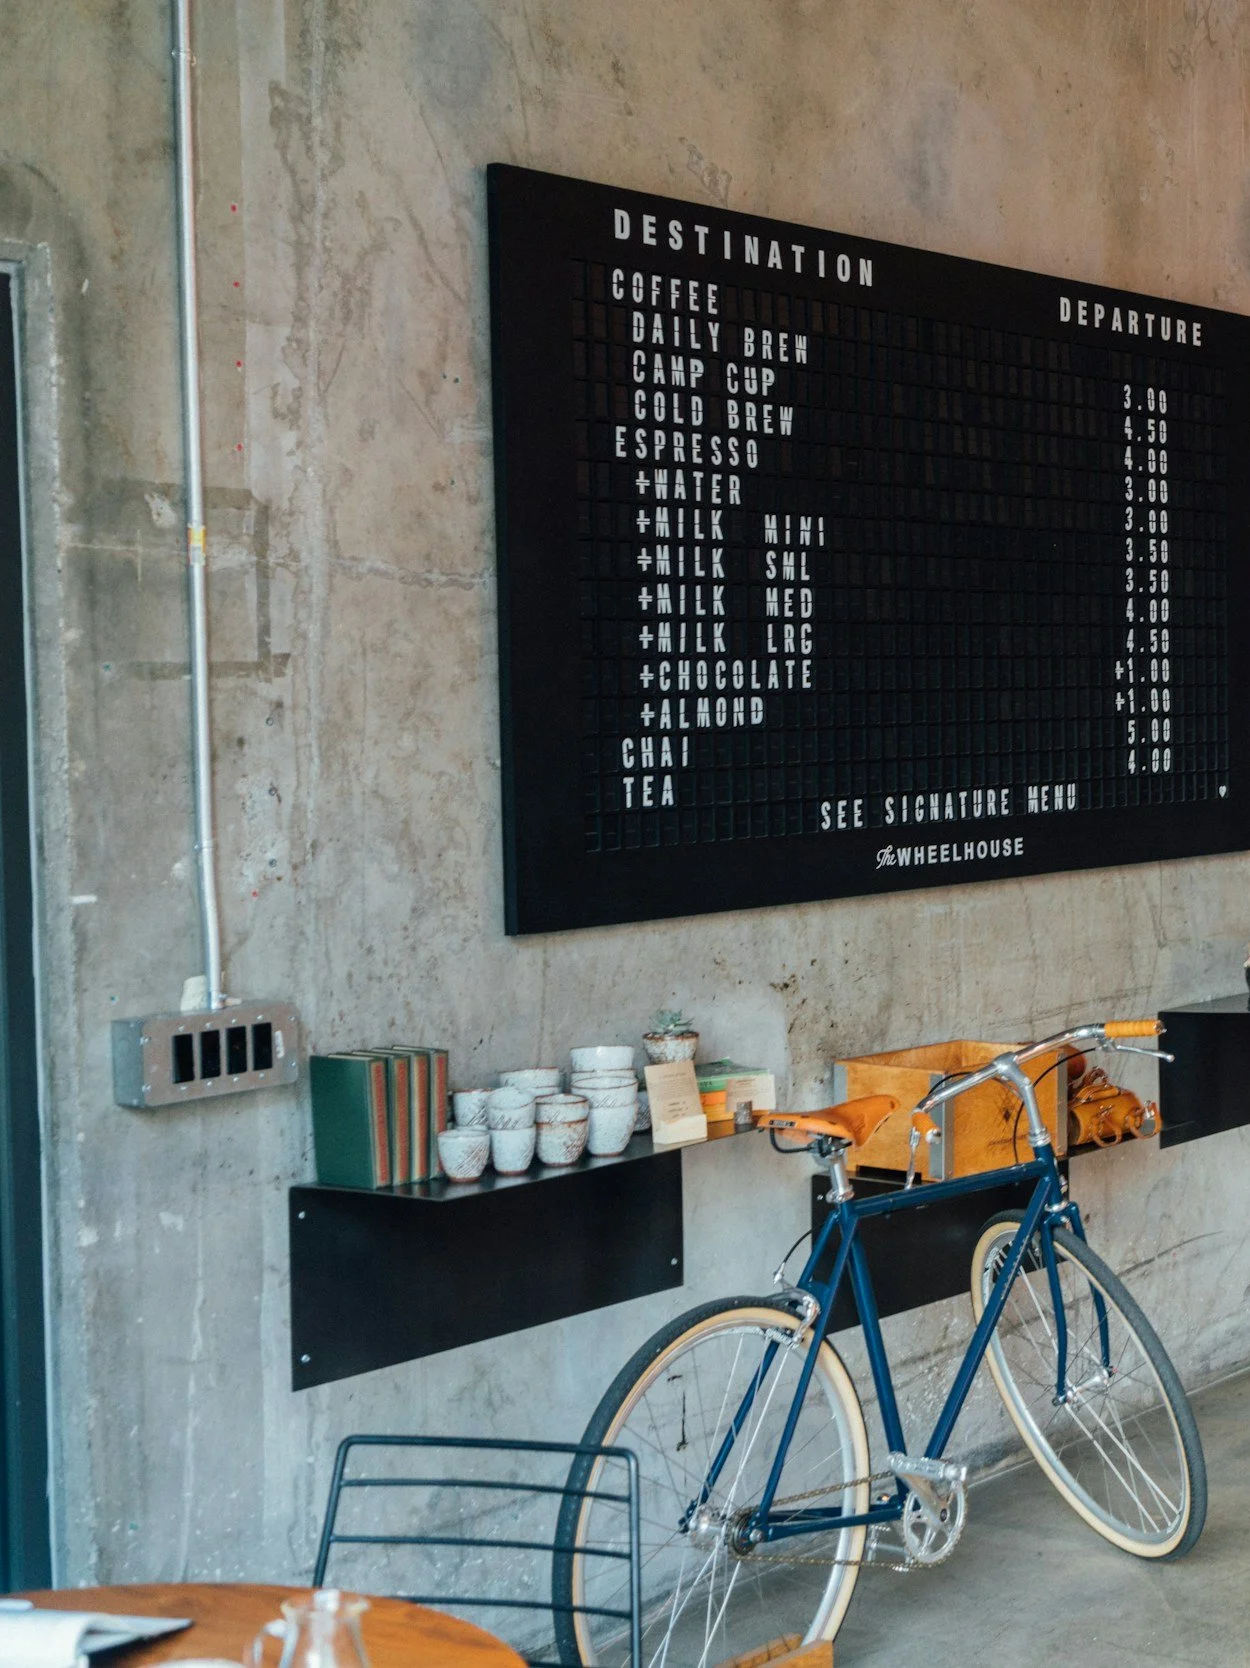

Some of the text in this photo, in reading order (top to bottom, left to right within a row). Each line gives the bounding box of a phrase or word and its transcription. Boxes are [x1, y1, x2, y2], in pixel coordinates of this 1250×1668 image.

[614, 209, 873, 287] DESTINATION
[612, 268, 718, 314] COFFEE
[1060, 297, 1201, 346] DEPARTURE
[633, 311, 1167, 414] DAILY BREW 3.00
[633, 350, 1167, 444] CAMP CUP 4.50
[634, 389, 1168, 475] COLD BREW 4.00
[615, 426, 1168, 504] ESPRESSO 3.00
[635, 469, 1168, 534] +WATER 3.00
[636, 507, 1168, 564] +MILK MINI 3.50
[637, 545, 1169, 593] +MILK SML 3.50
[638, 583, 1169, 623] +MILK MED 4.00
[639, 622, 1169, 655] +MILK LRG 4.50
[639, 658, 1170, 691] +CHOCOLATE +1.00
[640, 688, 1170, 729] +ALMOND +1.00
[622, 718, 1170, 769] CHAI 5.00
[623, 748, 1171, 808] TEA 4.00
[821, 783, 1076, 830] SEE SIGNATURE MENU
[876, 837, 1024, 870] The WHEELHOUSE
